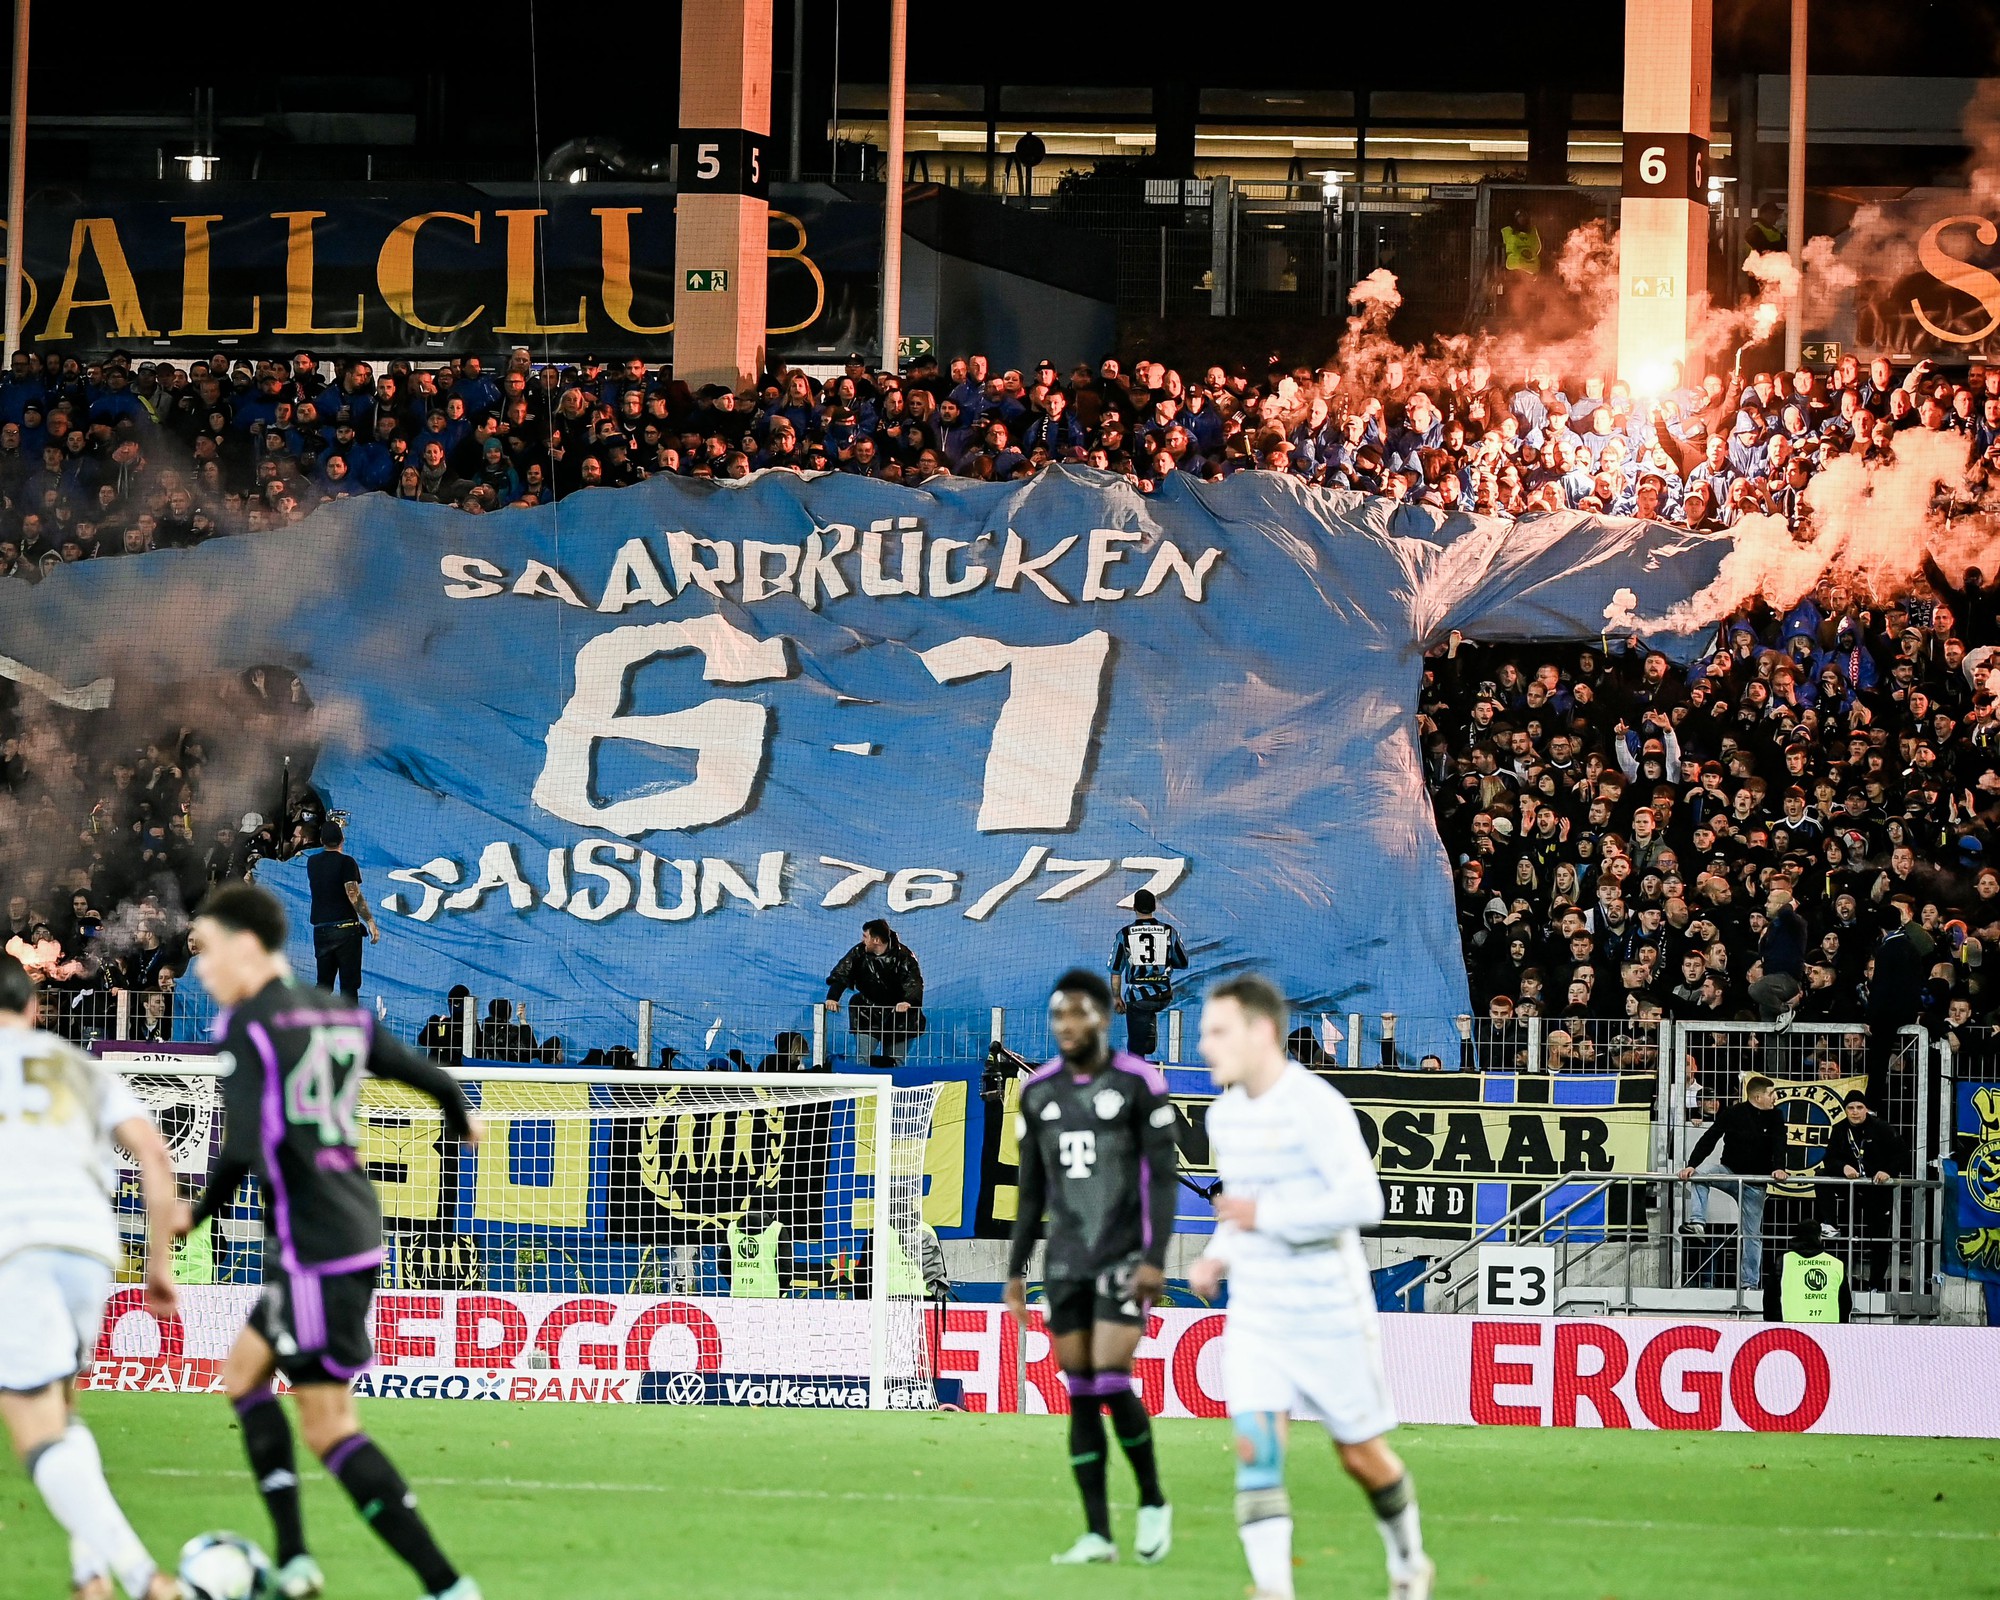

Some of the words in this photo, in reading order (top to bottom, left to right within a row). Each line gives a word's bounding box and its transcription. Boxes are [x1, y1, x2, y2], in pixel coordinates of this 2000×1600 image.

[697, 143, 720, 179] 5
[751, 147, 759, 184] 5
[1639, 146, 1667, 184] 6
[1695, 152, 1702, 188] 6
[0, 204, 824, 342] ALLCLUB
[441, 516, 1222, 614] SAARBRÜCKEN
[1139, 933, 1155, 964] 3
[1776, 1085, 1844, 1120] BERTA
[1172, 1104, 1615, 1174] NSAAR
[1389, 1185, 1464, 1215] END
[1487, 1265, 1546, 1306] E3
[1804, 1292, 1828, 1300] SERVICE
[1808, 1309, 1823, 1317] 217
[375, 1295, 722, 1371] ERGO
[350, 1373, 470, 1399] ARGO
[509, 1377, 630, 1403] BANK
[725, 1378, 931, 1408] Volkswaen
[1470, 1321, 1830, 1433] ERGO
